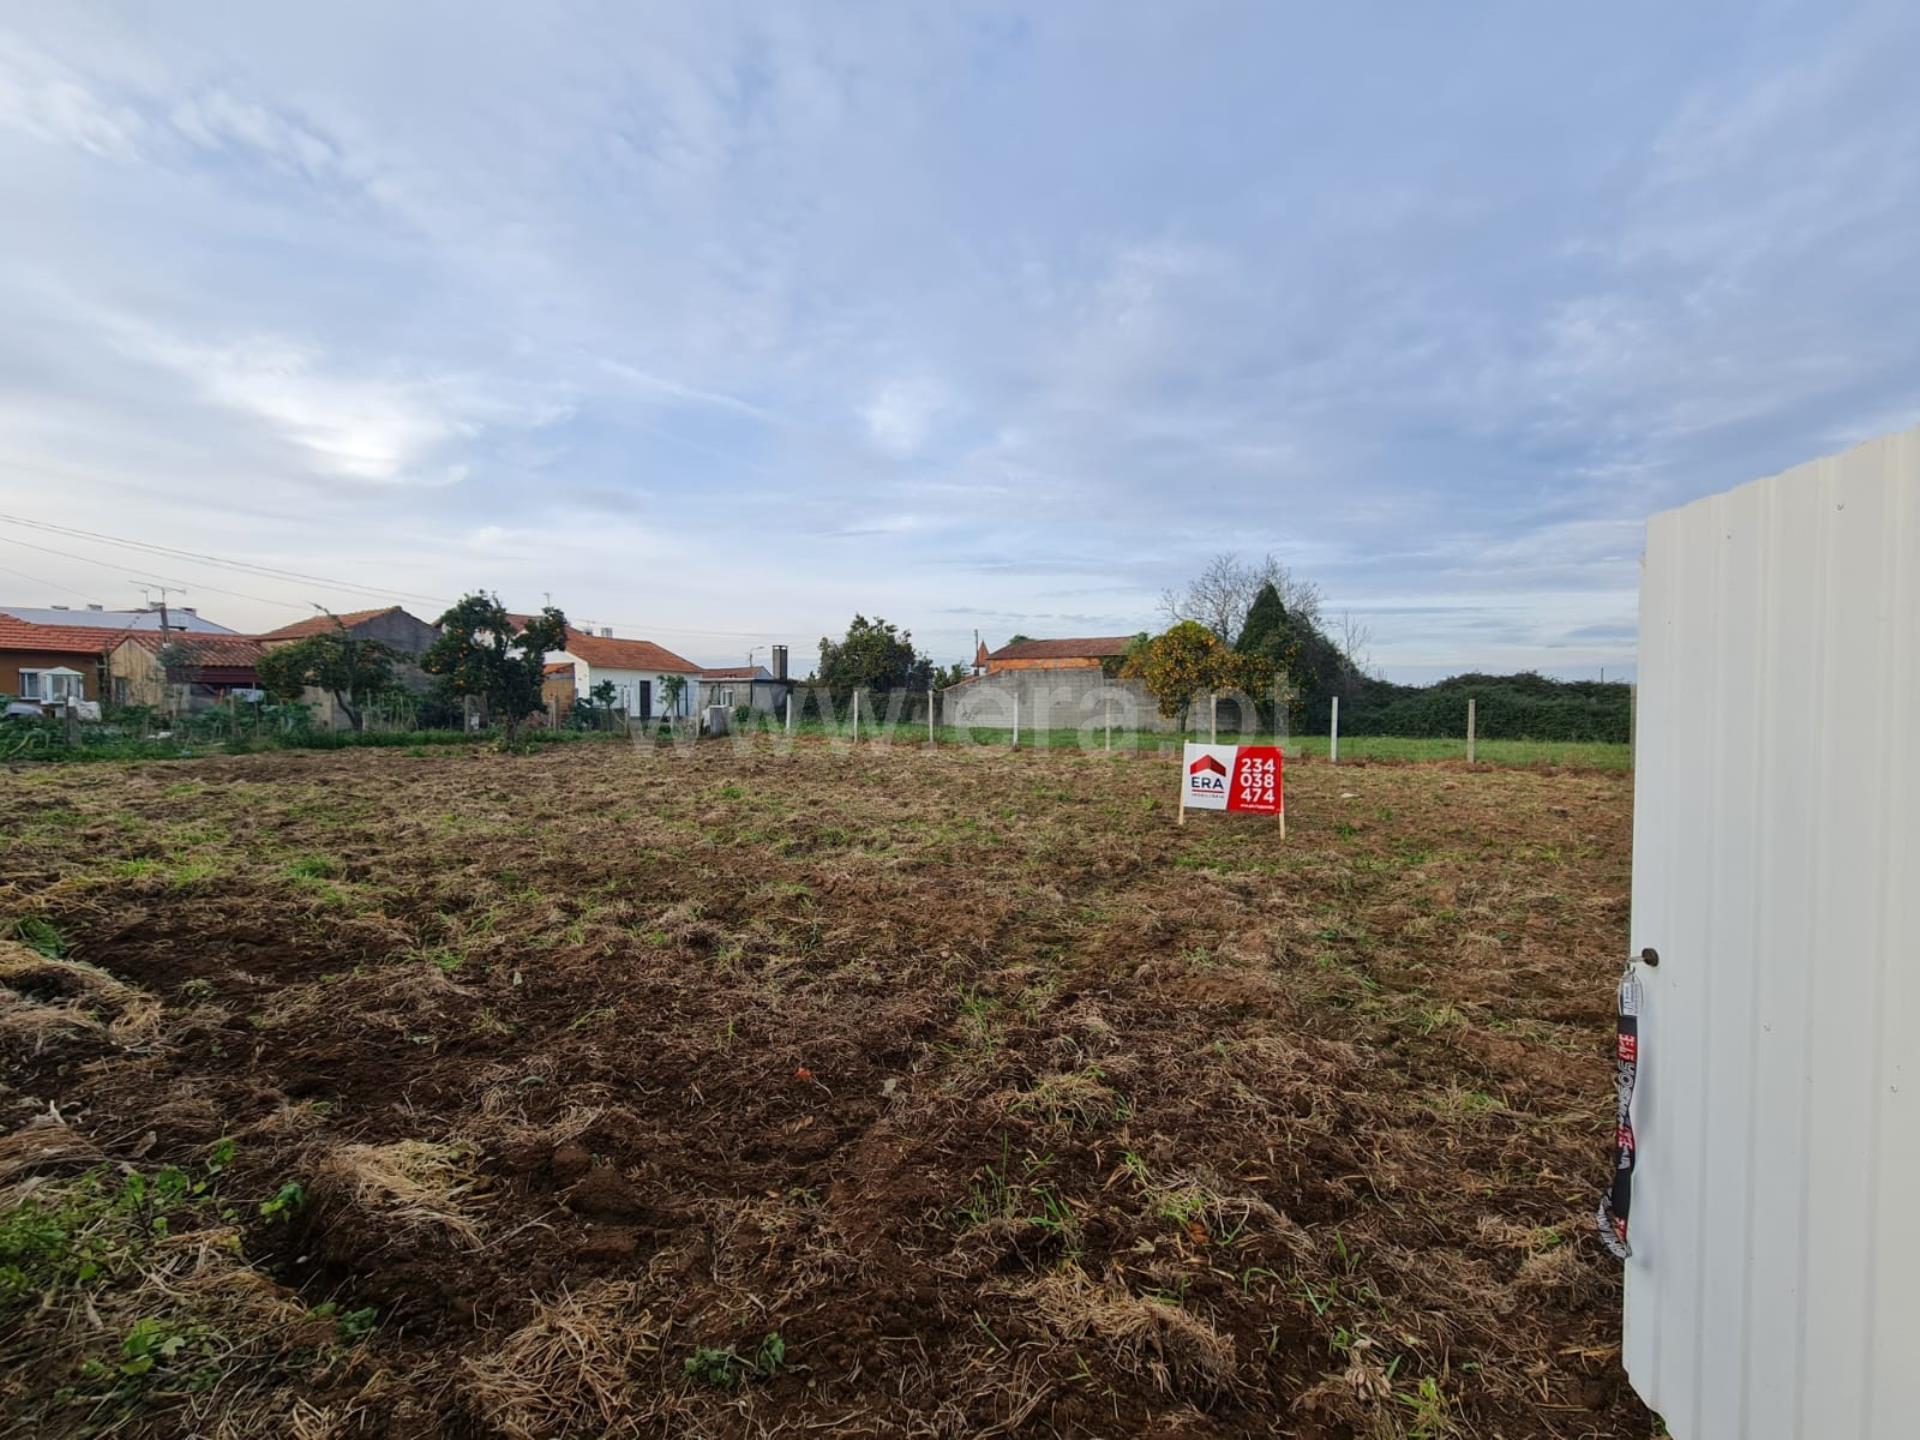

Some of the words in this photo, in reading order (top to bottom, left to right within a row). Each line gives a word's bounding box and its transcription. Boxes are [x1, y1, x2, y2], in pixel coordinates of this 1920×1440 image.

[1240, 758, 1275, 774] 234
[1191, 777, 1224, 789] ERA
[1240, 773, 1275, 788] 038
[1240, 788, 1275, 803] 474
